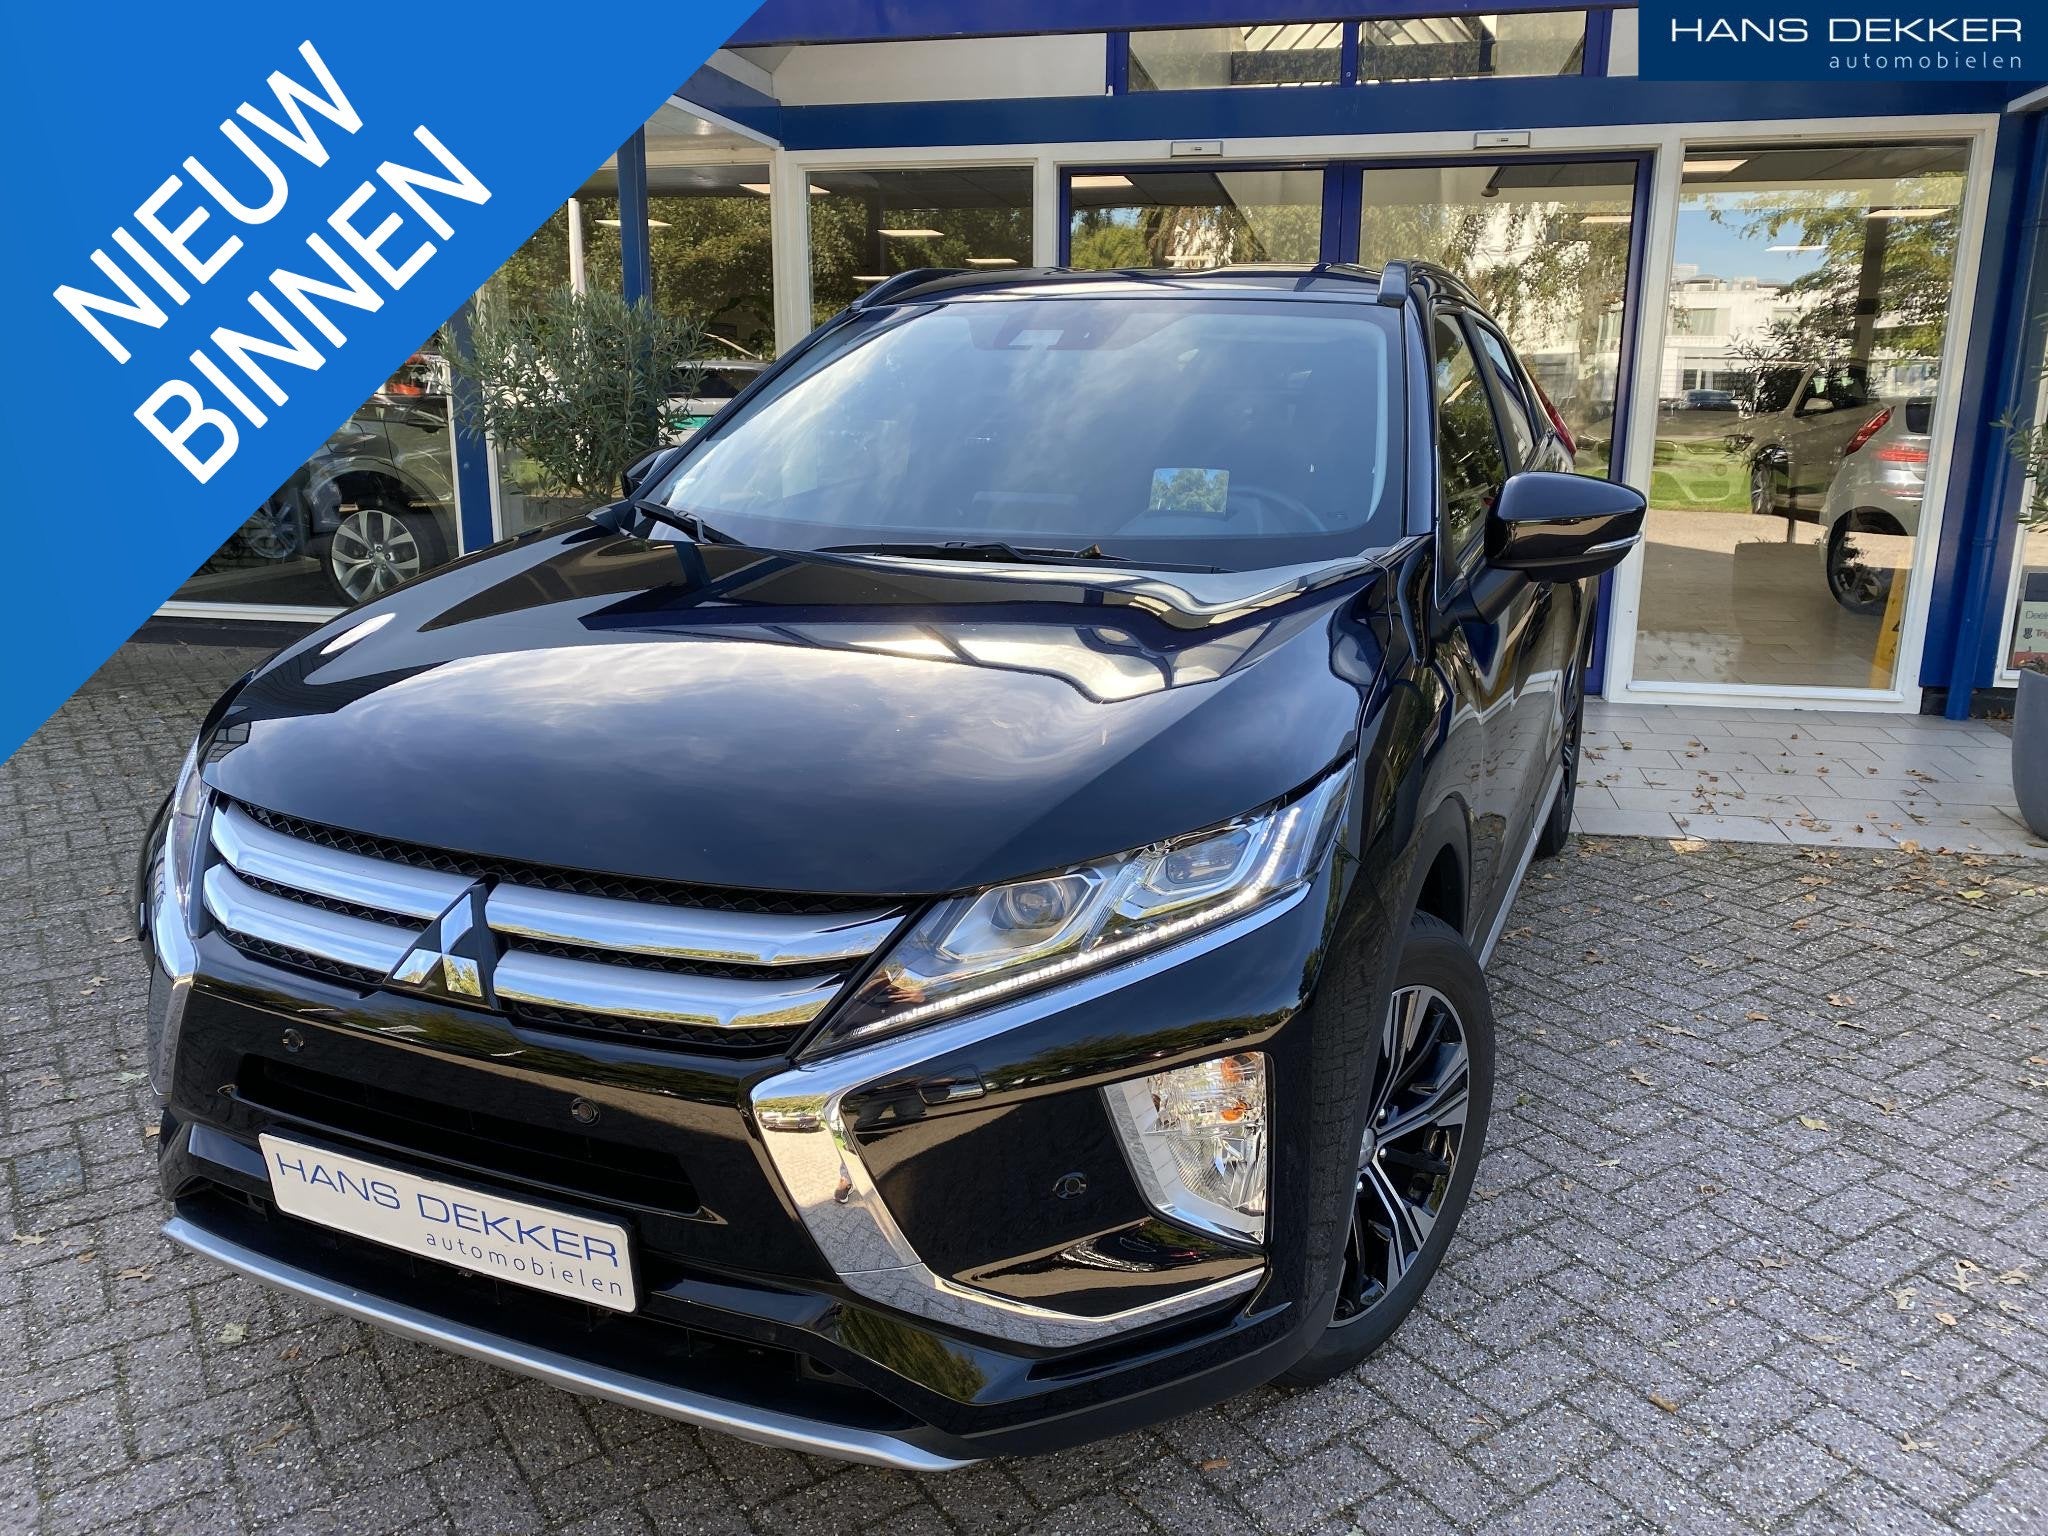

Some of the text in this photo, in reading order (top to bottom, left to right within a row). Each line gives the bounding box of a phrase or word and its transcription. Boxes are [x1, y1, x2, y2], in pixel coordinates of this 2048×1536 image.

[275, 1152, 619, 1268] HANS DEKKER
[426, 1231, 623, 1297] automobielen
